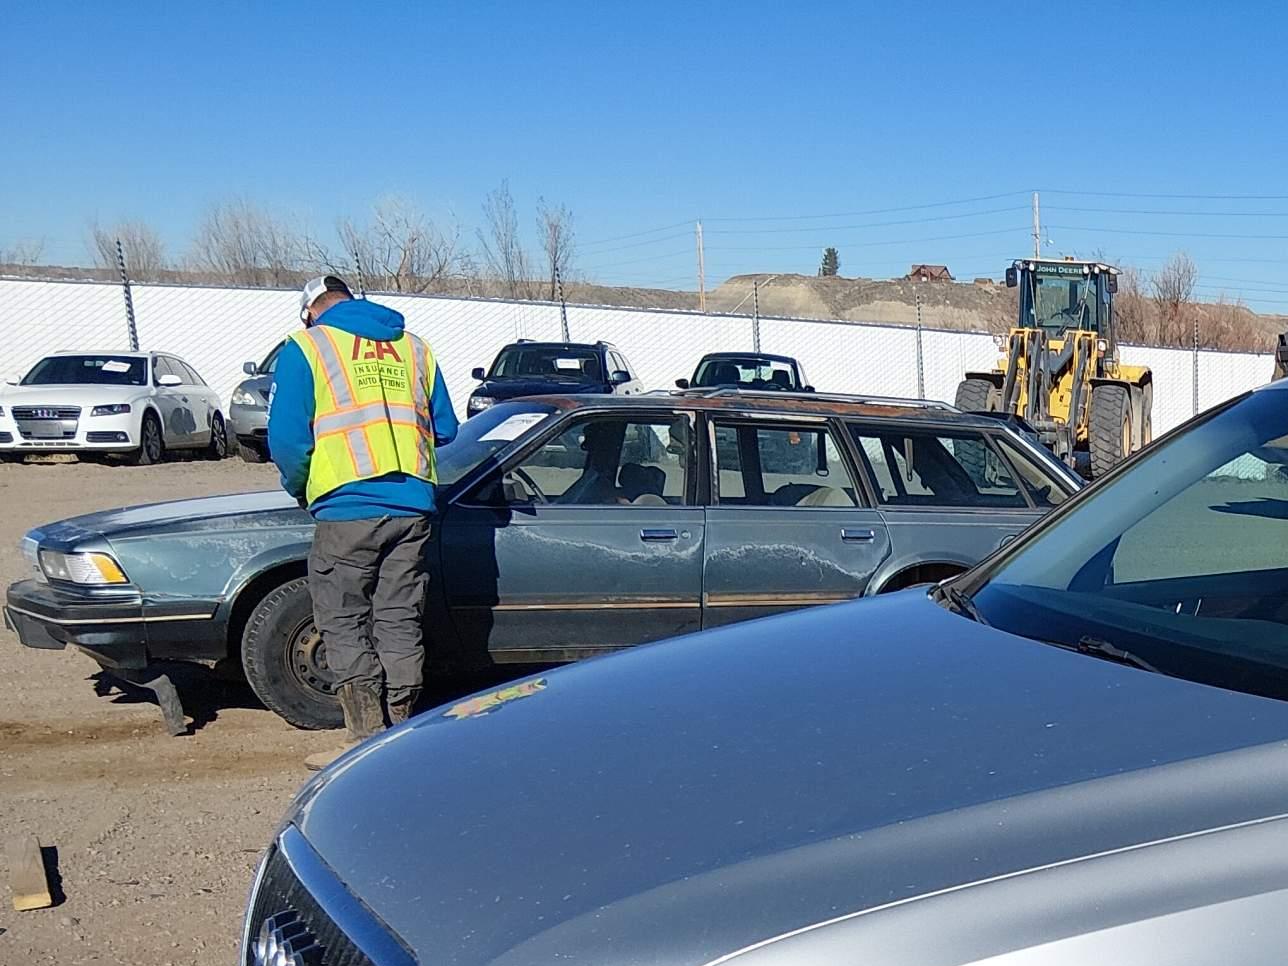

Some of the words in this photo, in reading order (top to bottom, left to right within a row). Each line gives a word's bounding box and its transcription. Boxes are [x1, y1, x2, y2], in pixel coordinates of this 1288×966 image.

[1036, 265, 1057, 273] JOHN
[1058, 266, 1083, 274] DEERE
[353, 365, 405, 377] INSUANCE
[358, 377, 377, 387] AUTO
